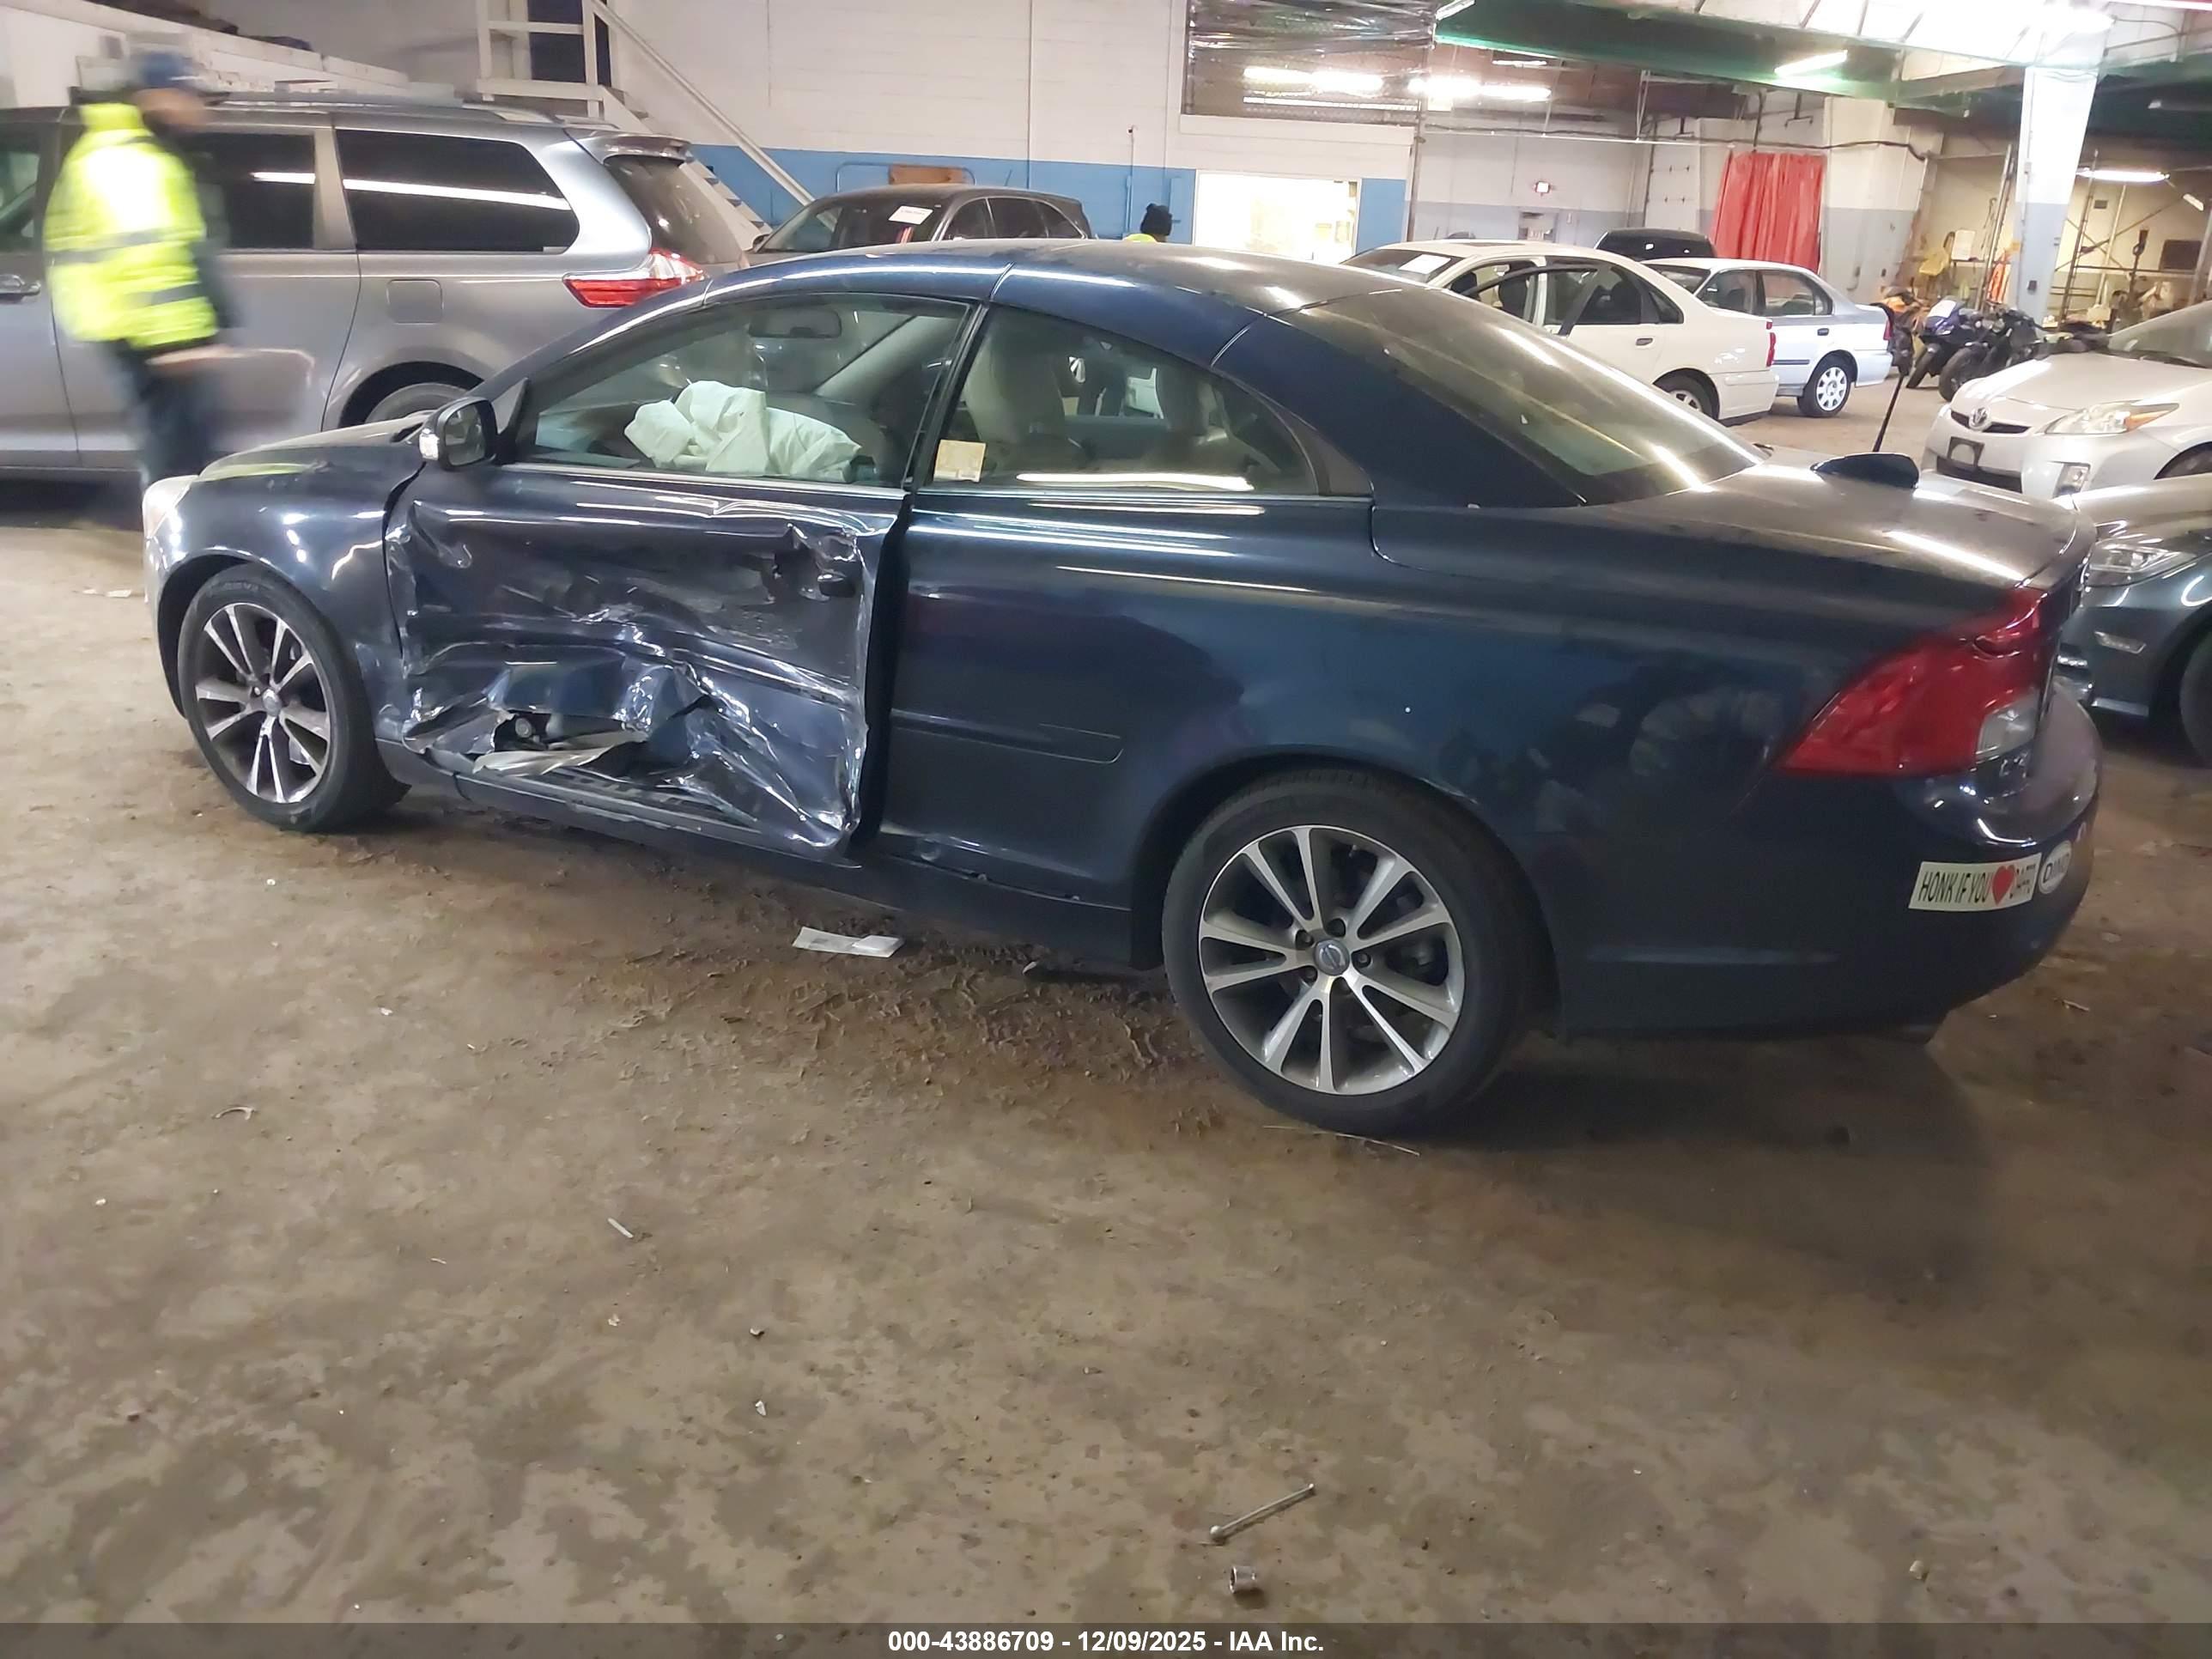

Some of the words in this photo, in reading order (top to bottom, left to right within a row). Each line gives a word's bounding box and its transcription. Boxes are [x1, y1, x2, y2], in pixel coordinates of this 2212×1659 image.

[1917, 871, 1958, 902] HONK
[1954, 872, 1972, 903] IF
[1967, 871, 1994, 903] YOU
